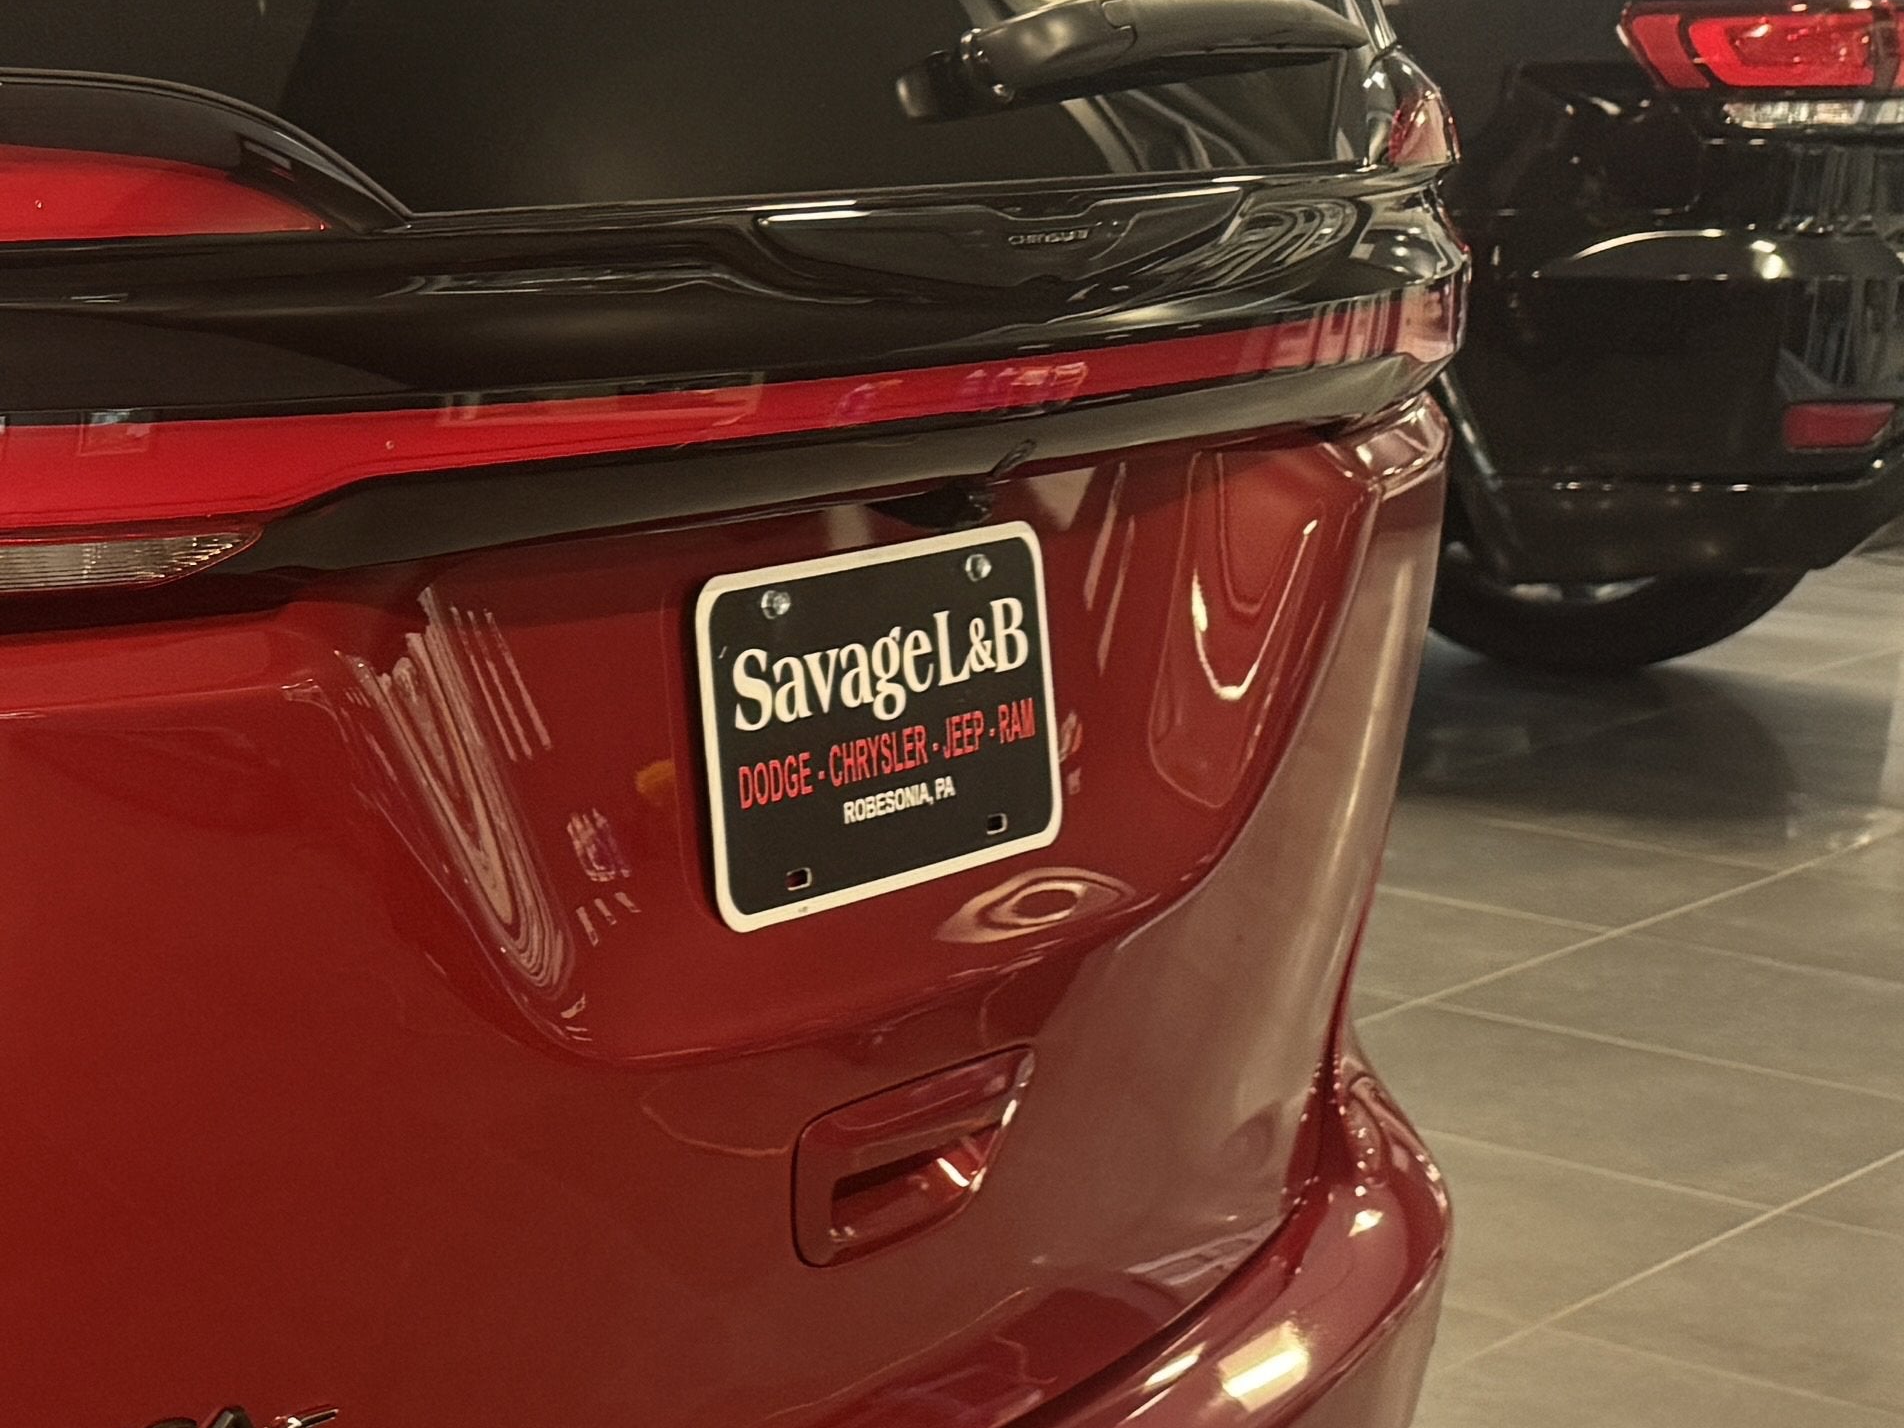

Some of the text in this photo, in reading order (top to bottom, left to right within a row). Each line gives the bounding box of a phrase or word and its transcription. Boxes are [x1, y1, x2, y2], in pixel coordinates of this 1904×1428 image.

[738, 751, 814, 810] DODGE
[828, 725, 928, 787] CHRYSLER
[943, 711, 985, 759] JEEP
[998, 698, 1036, 743] RAM
[843, 775, 956, 825] ROBESONIA, PA
